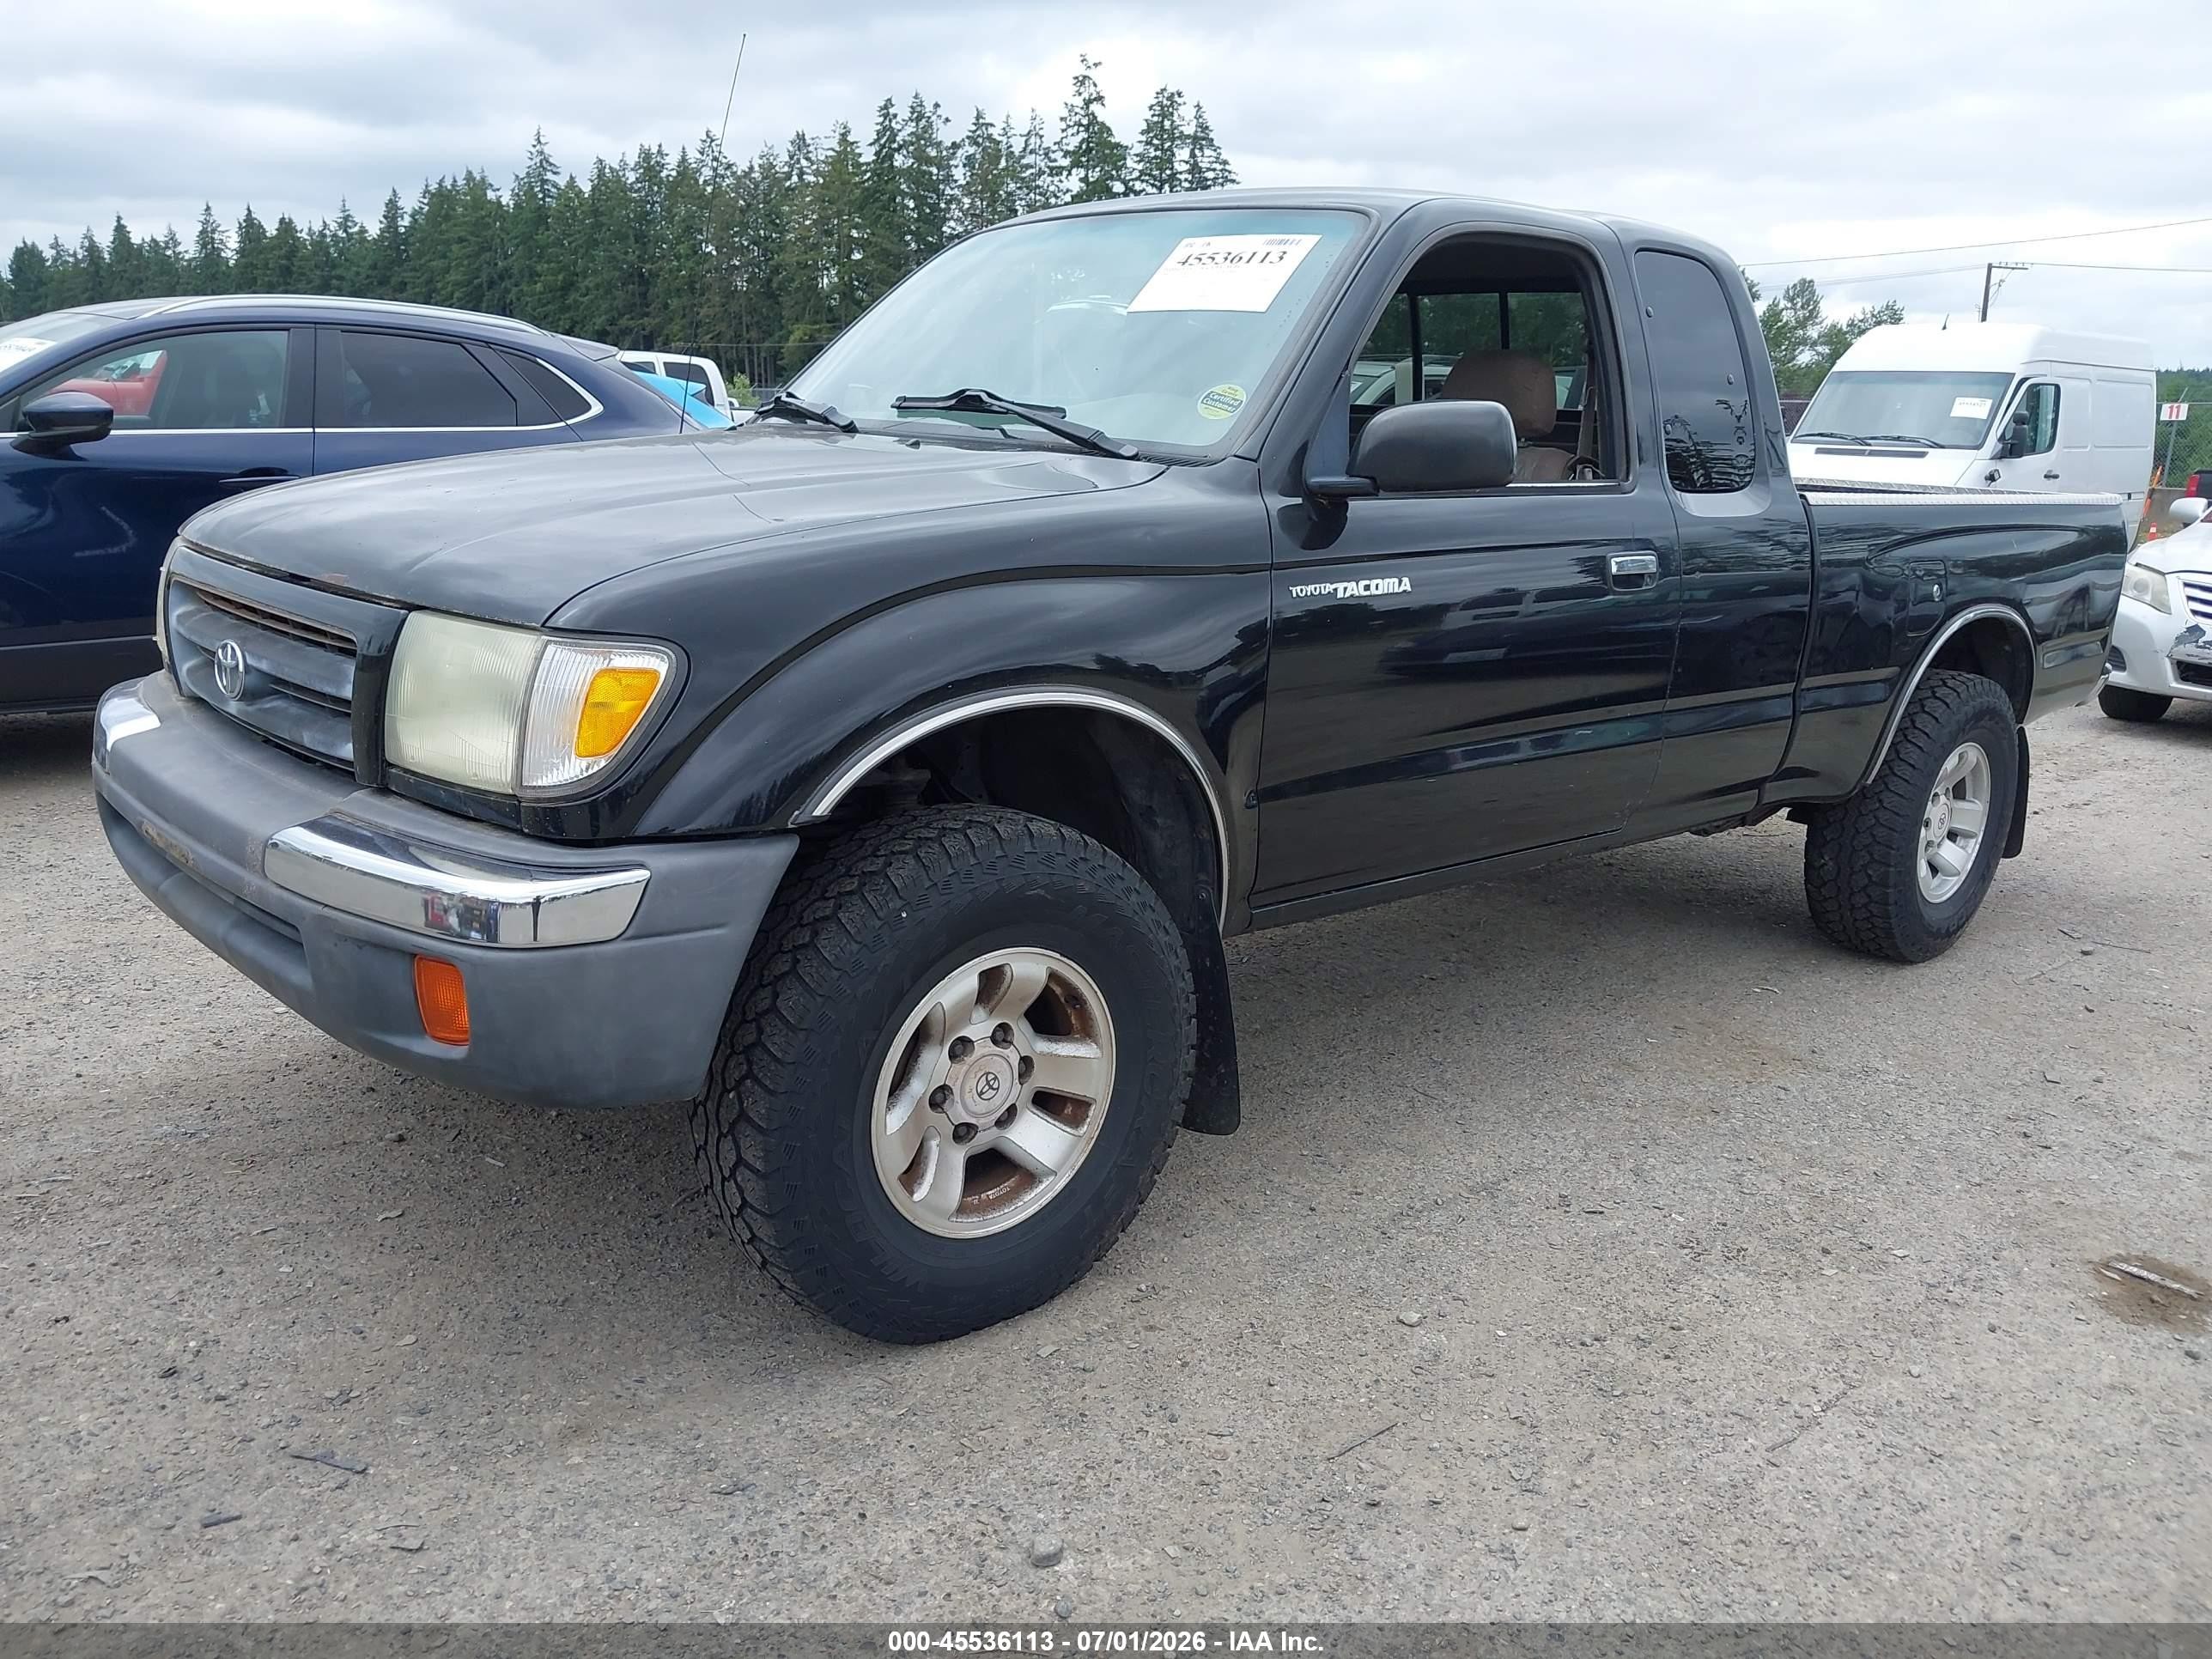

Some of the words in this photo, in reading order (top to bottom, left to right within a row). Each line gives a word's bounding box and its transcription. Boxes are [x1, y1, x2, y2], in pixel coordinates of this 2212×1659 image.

[1176, 251, 1288, 266] 45536113
[1202, 398, 1237, 412] Customer
[2167, 404, 2182, 420] 11
[1289, 583, 1334, 599] TOYOTA
[1332, 576, 1413, 599] TACOMA
